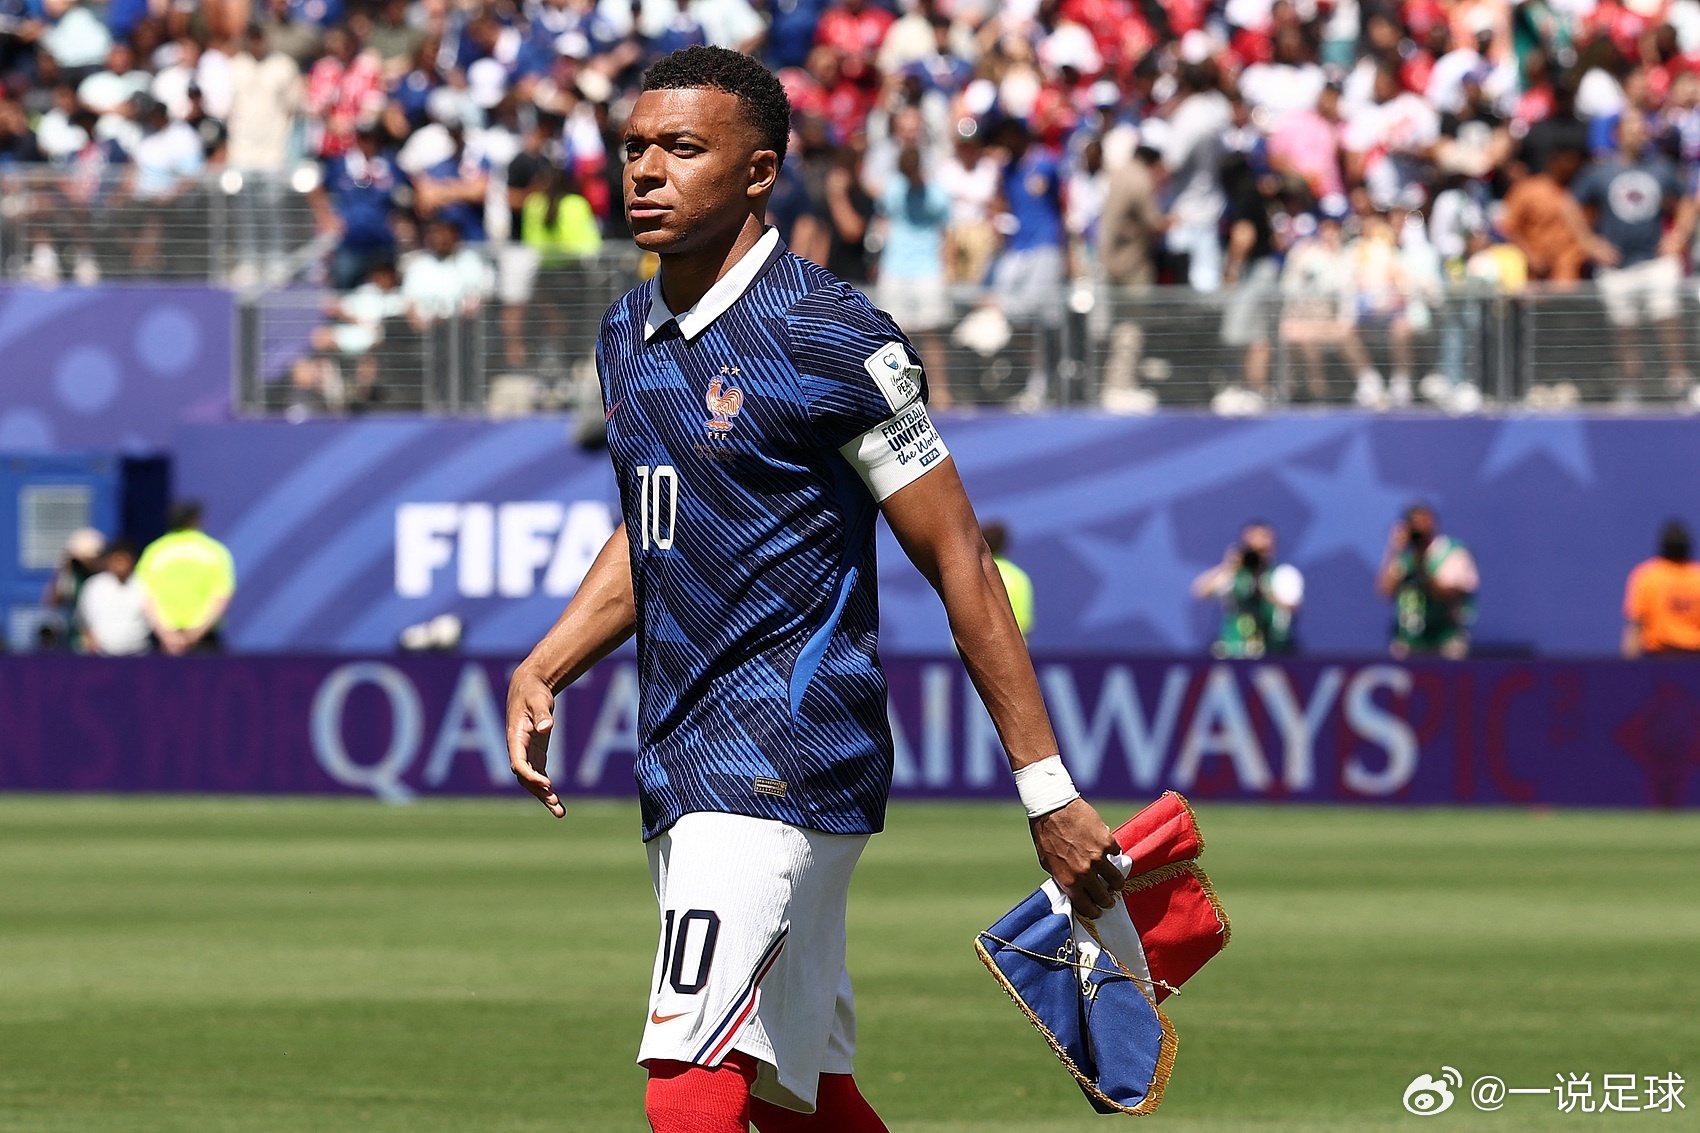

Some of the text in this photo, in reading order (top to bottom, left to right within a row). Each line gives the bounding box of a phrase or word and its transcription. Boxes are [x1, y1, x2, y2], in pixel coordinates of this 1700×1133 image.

[708, 431, 727, 440] FFF
[881, 405, 925, 439] FOOTBALL
[887, 416, 931, 452] UNITES
[896, 450, 917, 466] the
[920, 448, 940, 466] FIFA
[636, 465, 678, 550] 10
[395, 502, 615, 598] FIFA
[310, 661, 637, 803] QAA
[888, 661, 1419, 796] IWAYS
[658, 909, 721, 994] 10
